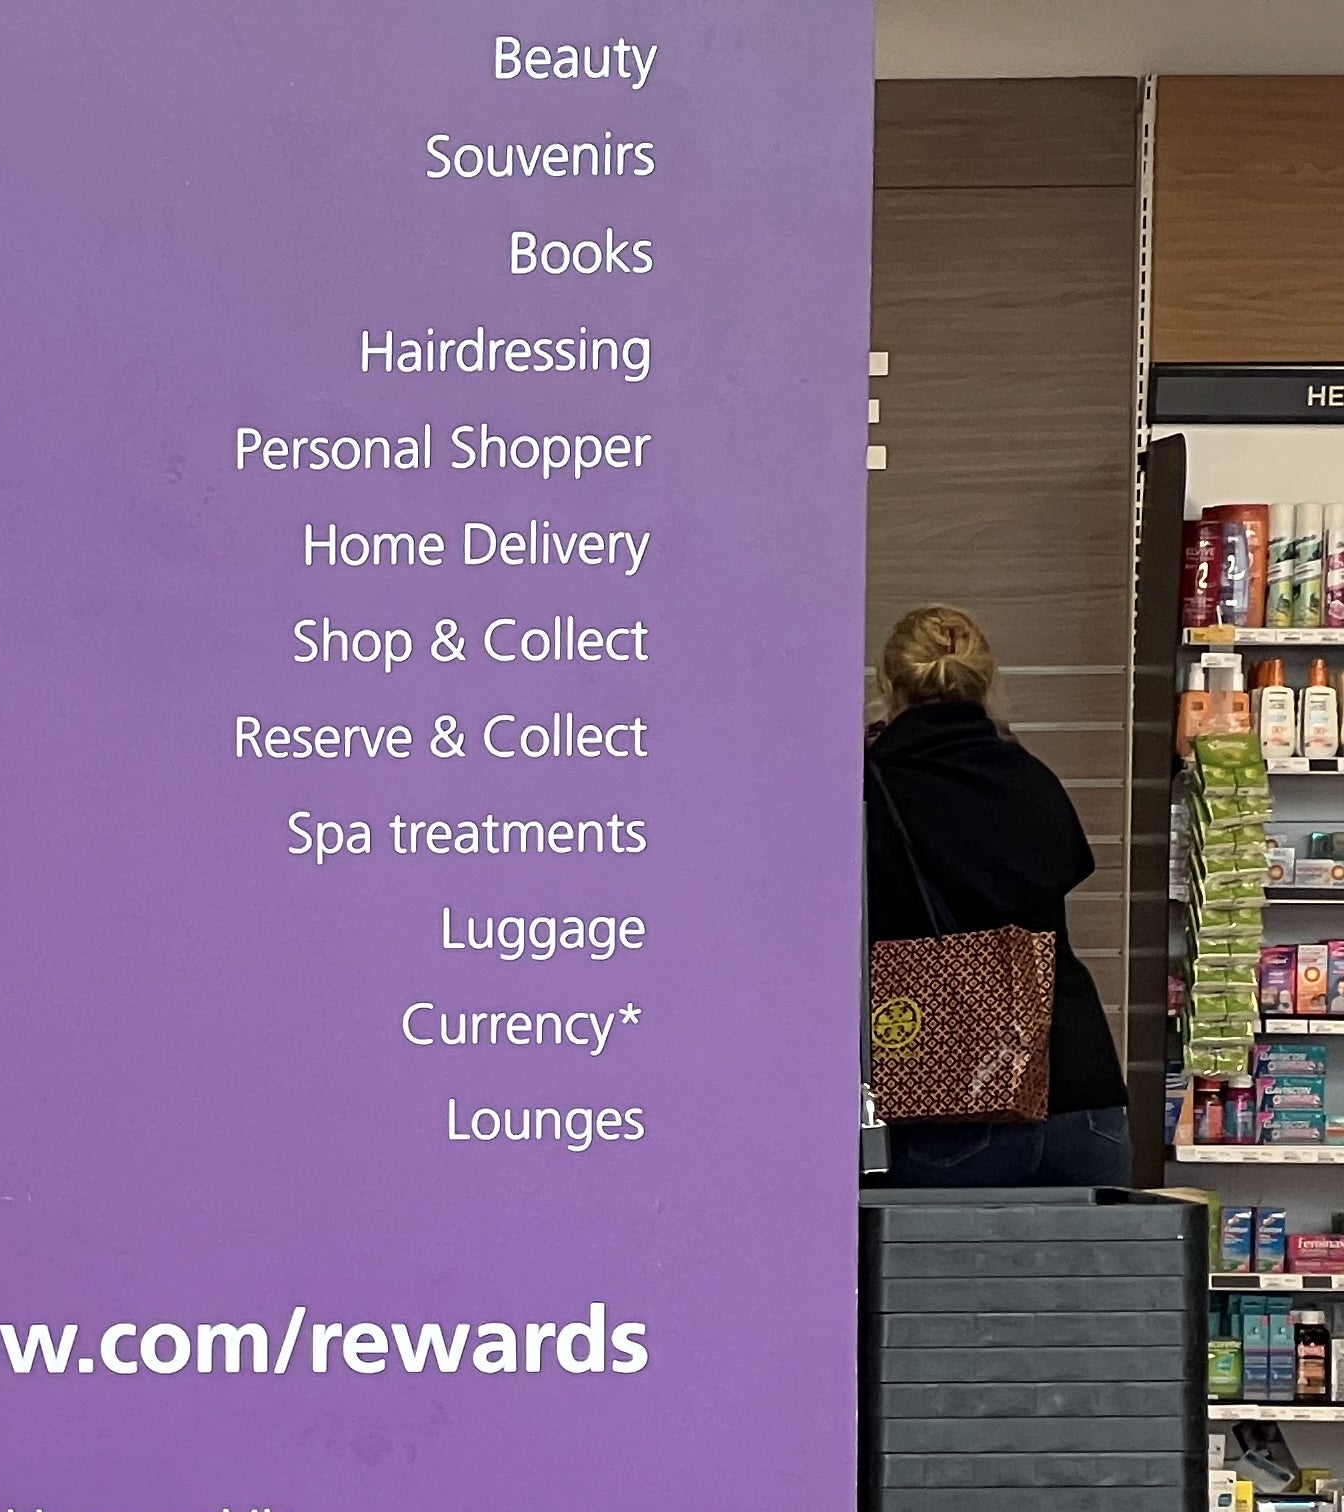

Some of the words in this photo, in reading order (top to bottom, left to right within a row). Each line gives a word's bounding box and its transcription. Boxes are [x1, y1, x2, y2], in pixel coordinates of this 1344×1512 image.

[495, 36, 658, 90] Beauty
[426, 131, 655, 178] Souvenirs
[511, 227, 653, 274] Books
[361, 326, 650, 382] Hairdressing
[237, 423, 431, 470] Personal
[451, 423, 652, 480] Shopper
[305, 524, 445, 566] Home
[464, 519, 650, 576] Delivery
[294, 617, 412, 673] Shop
[430, 618, 466, 662] &
[484, 615, 649, 662] Collect
[236, 716, 412, 758] Reserve
[430, 715, 466, 758] &
[483, 712, 648, 758] Collect
[288, 811, 371, 865] Spa
[389, 814, 647, 854] treatments
[443, 907, 645, 961] Luggage
[448, 1098, 645, 1152] Lounges
